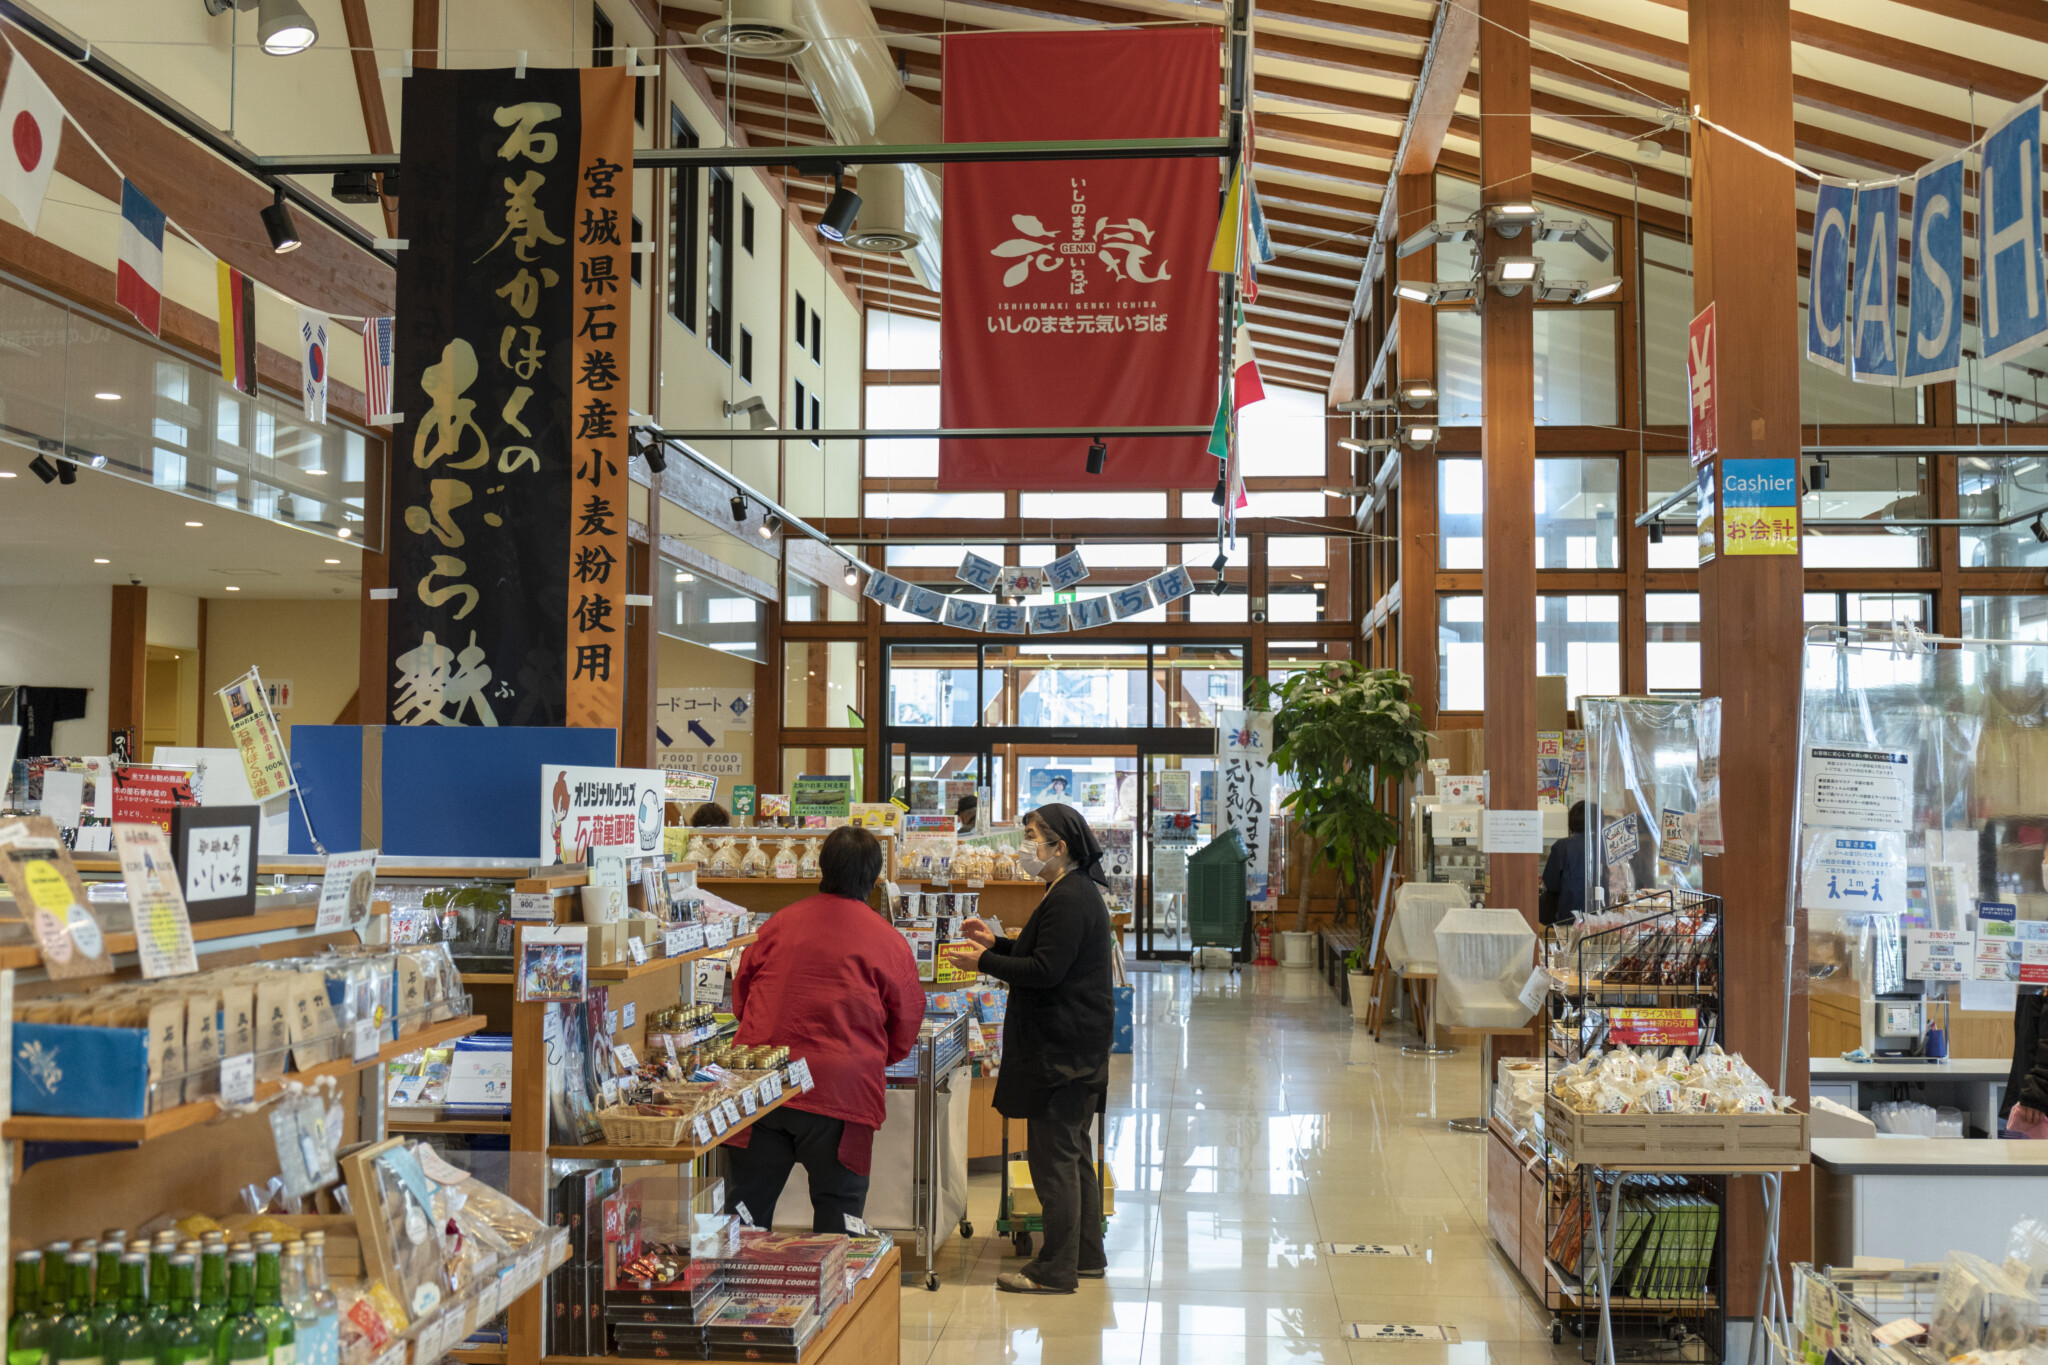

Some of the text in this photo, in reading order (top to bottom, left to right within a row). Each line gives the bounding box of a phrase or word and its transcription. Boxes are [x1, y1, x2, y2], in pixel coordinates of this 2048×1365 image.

[1071, 177, 1087, 241] いしのまき
[1061, 243, 1096, 253] GENKI
[1814, 138, 2039, 361] CASH
[1070, 257, 1088, 295] いちば
[473, 101, 566, 473] 石巻かほくの
[998, 301, 1157, 310] ISHINOMAKI GENKI ICHIBA
[988, 313, 1168, 334] いしのまき元気いちば
[572, 157, 623, 682] 宮城県石巻産小麦粉使用
[1725, 475, 1794, 491] Cashier
[1727, 519, 1794, 541] お会計
[703, 764, 741, 772] COURT
[574, 782, 636, 807] オリジナルグッズ
[1624, 1009, 1683, 1019] サプライズ特価
[724, 1263, 818, 1273] MASKED RIDER COOKIE
[724, 1277, 817, 1287] MASKED RIDER COOKIE
